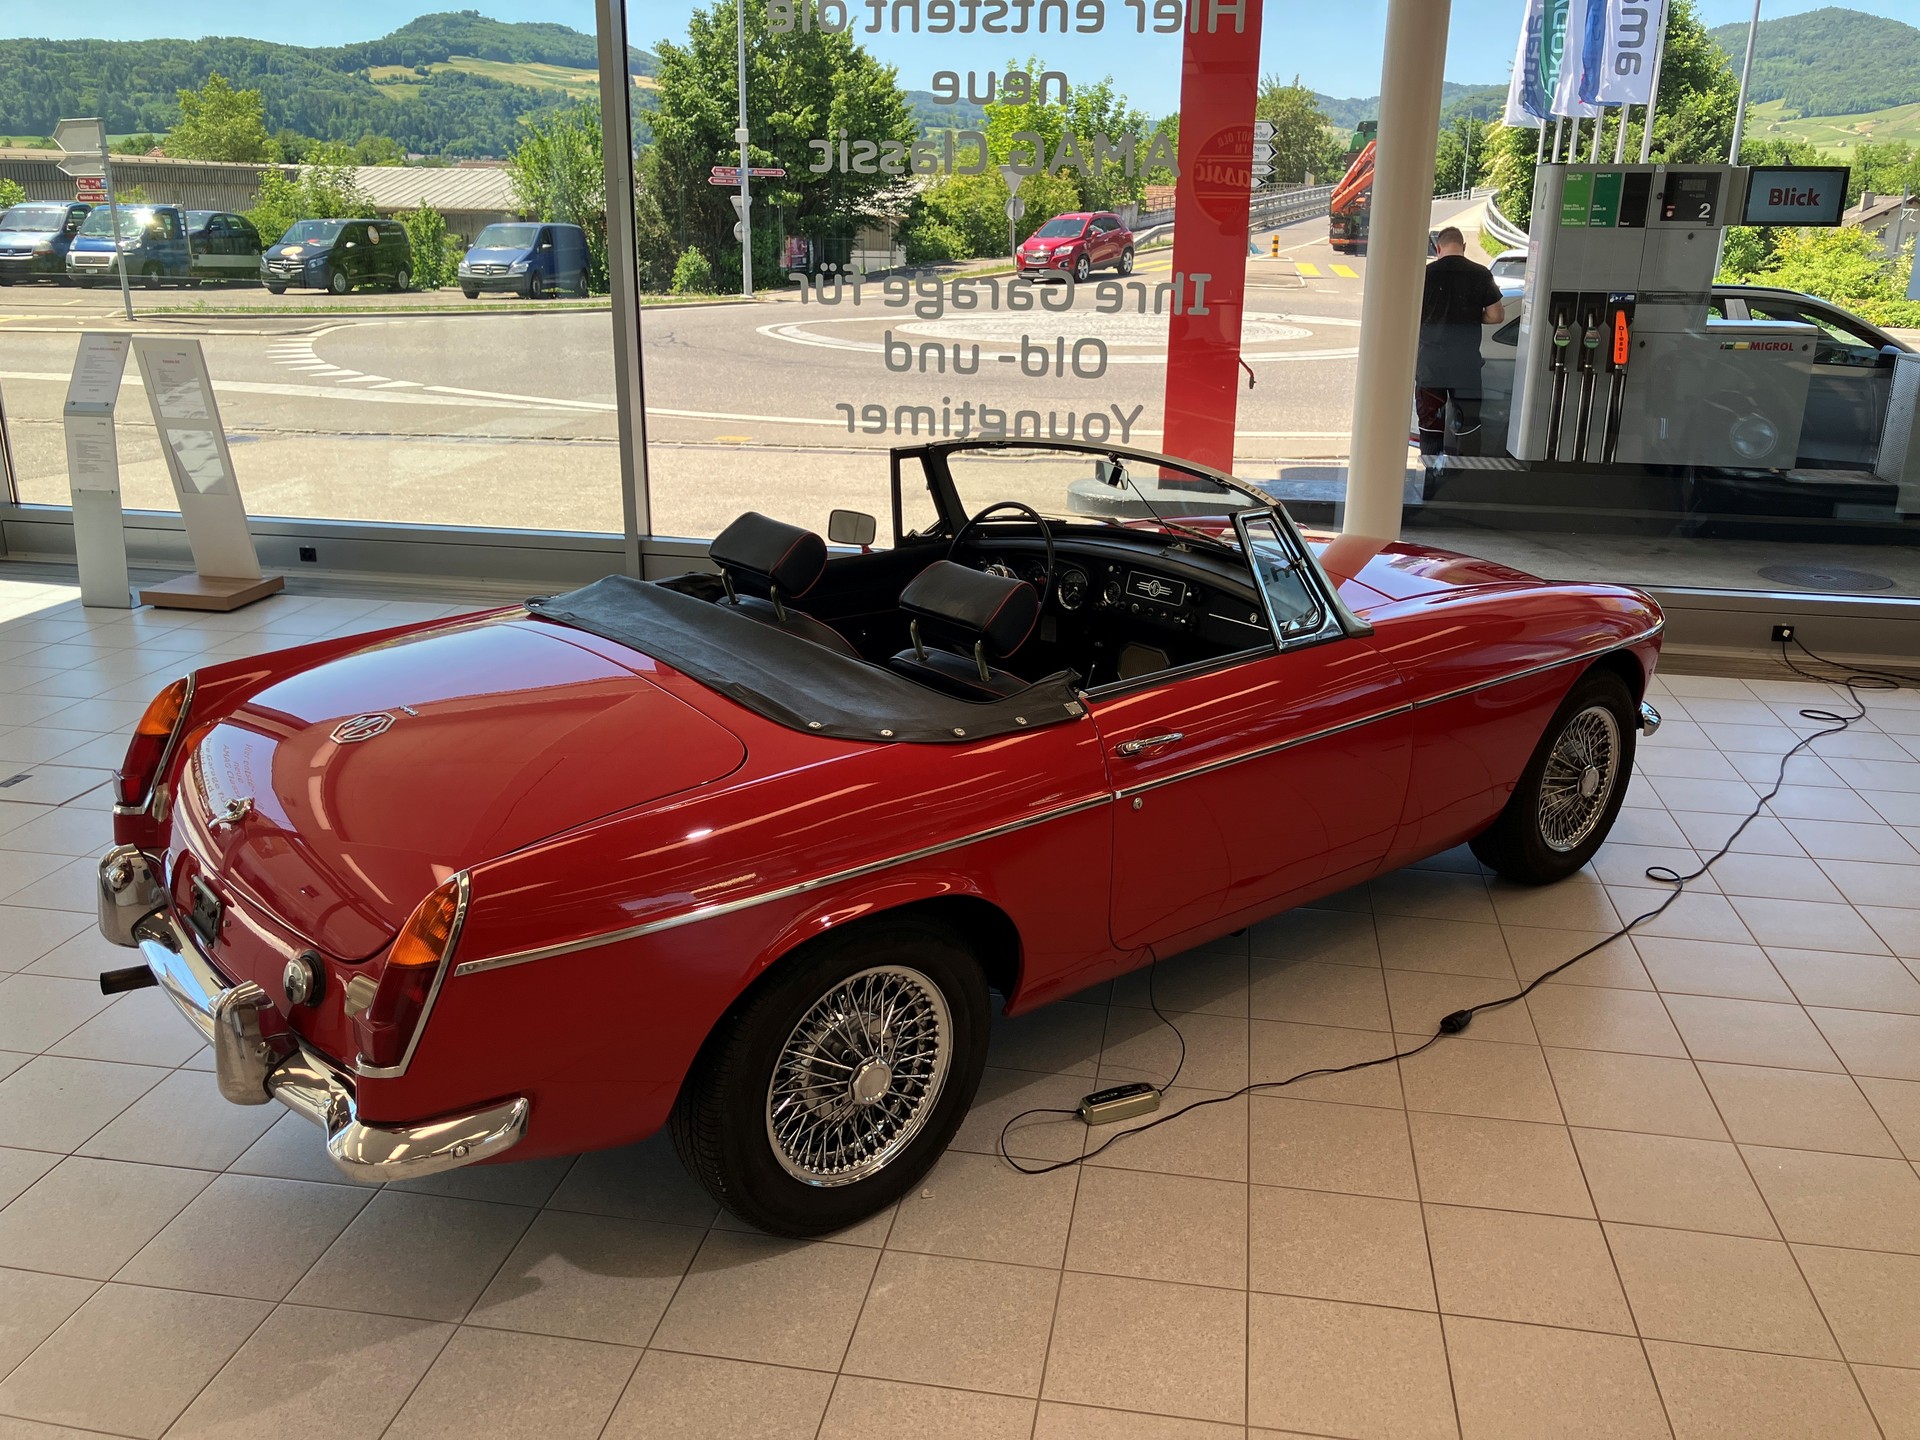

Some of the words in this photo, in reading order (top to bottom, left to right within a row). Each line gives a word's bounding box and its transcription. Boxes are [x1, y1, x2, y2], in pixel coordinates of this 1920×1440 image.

[1768, 187, 1821, 206] Blick
[1698, 202, 1711, 218] 2
[1749, 342, 1794, 351] MIGROL
[338, 715, 388, 740] MG
